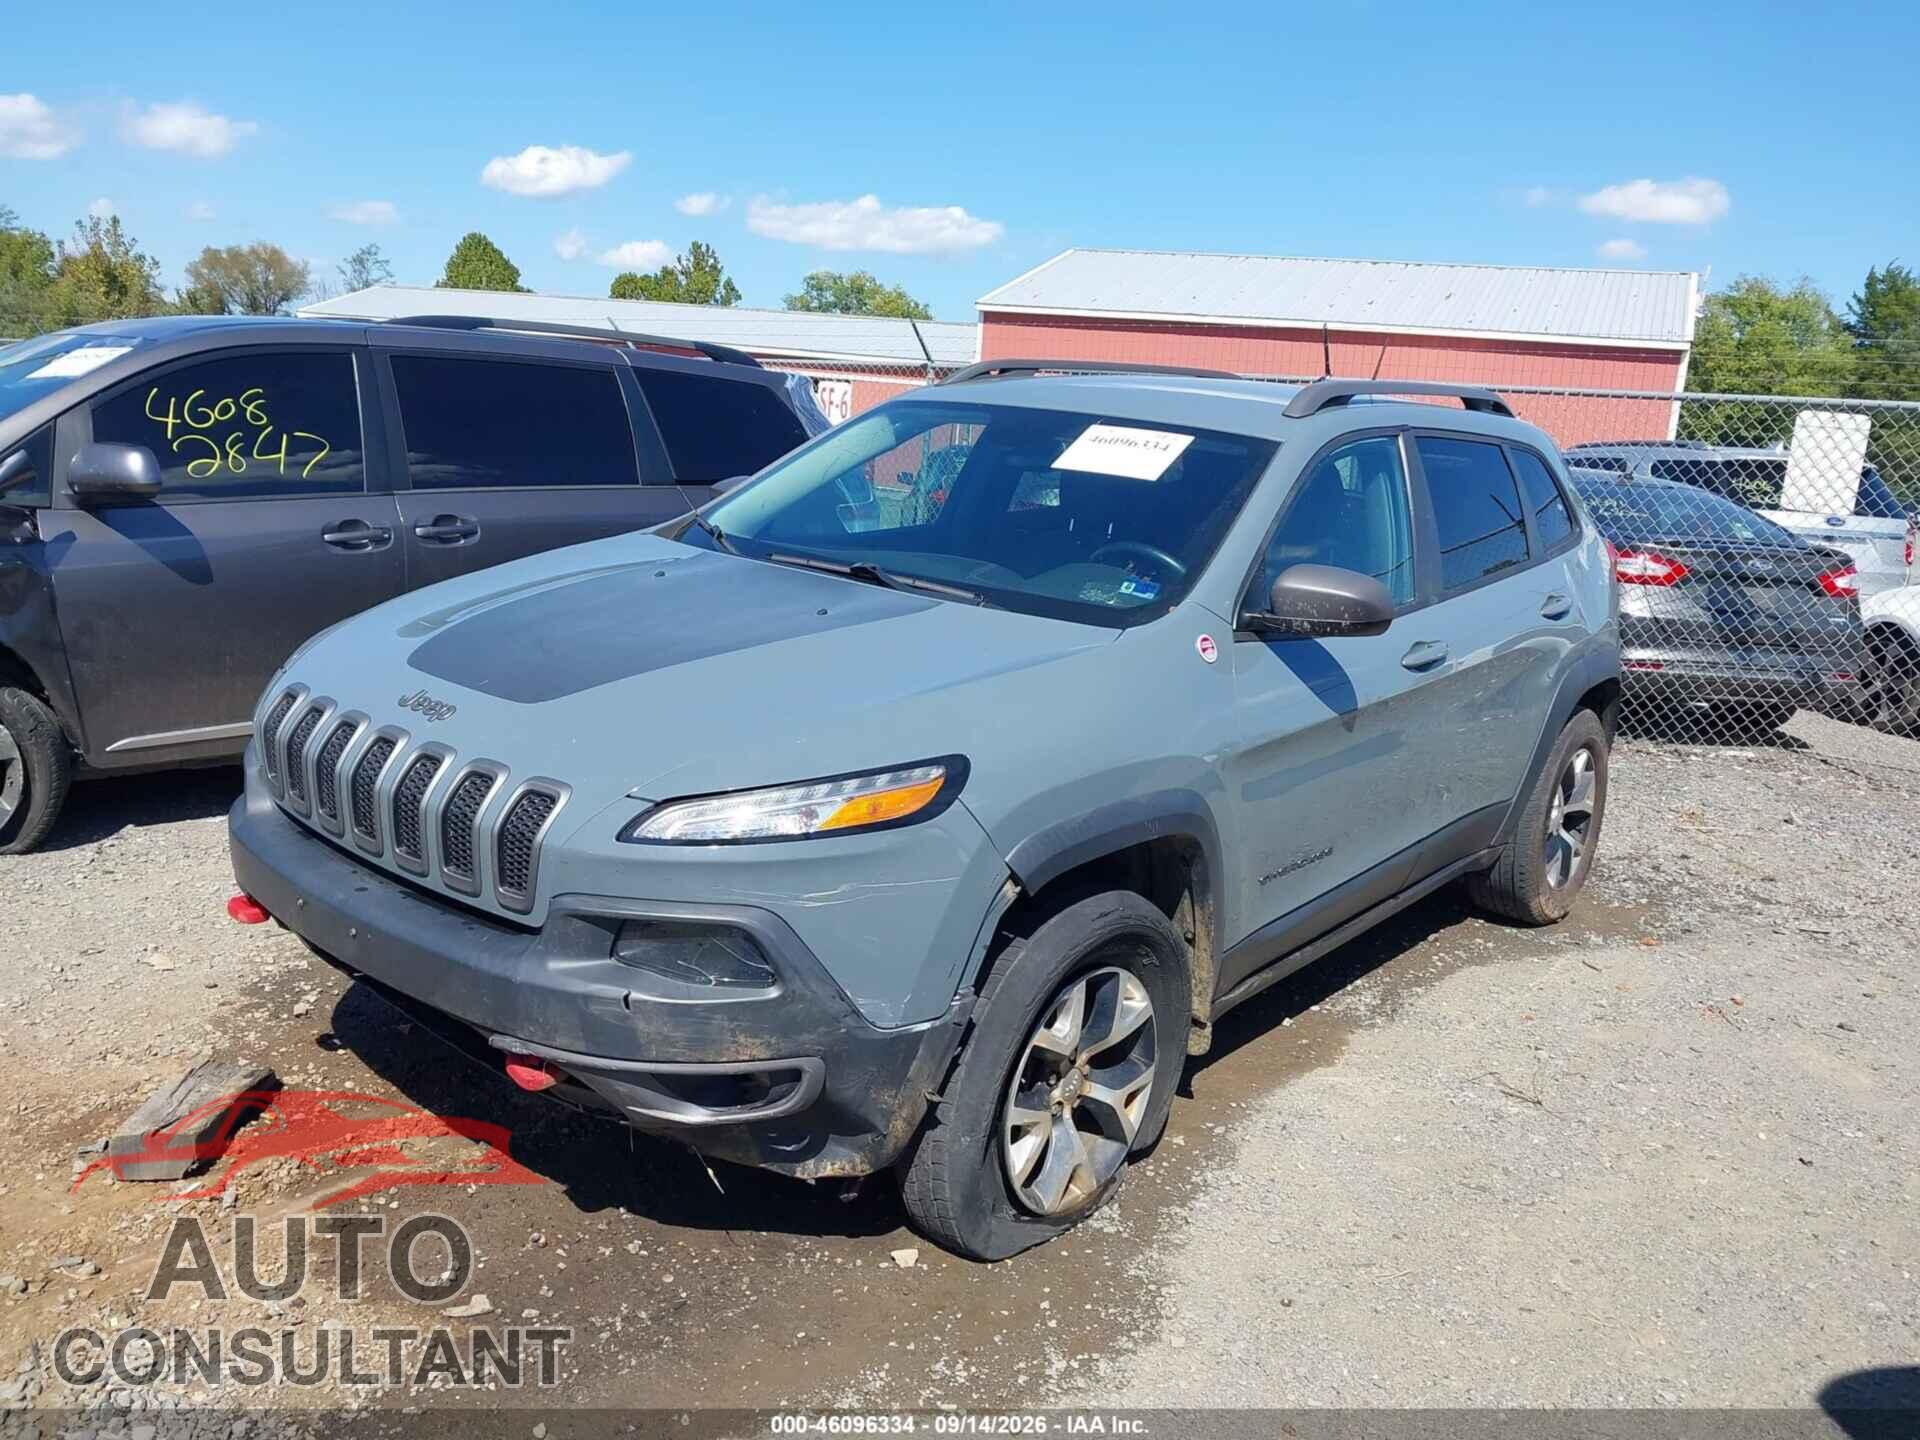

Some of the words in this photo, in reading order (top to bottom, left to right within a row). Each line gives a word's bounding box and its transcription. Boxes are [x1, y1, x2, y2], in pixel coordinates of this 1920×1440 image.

[145, 387, 268, 440] 4608
[172, 425, 330, 479] 2847
[398, 689, 457, 723] Jeep
